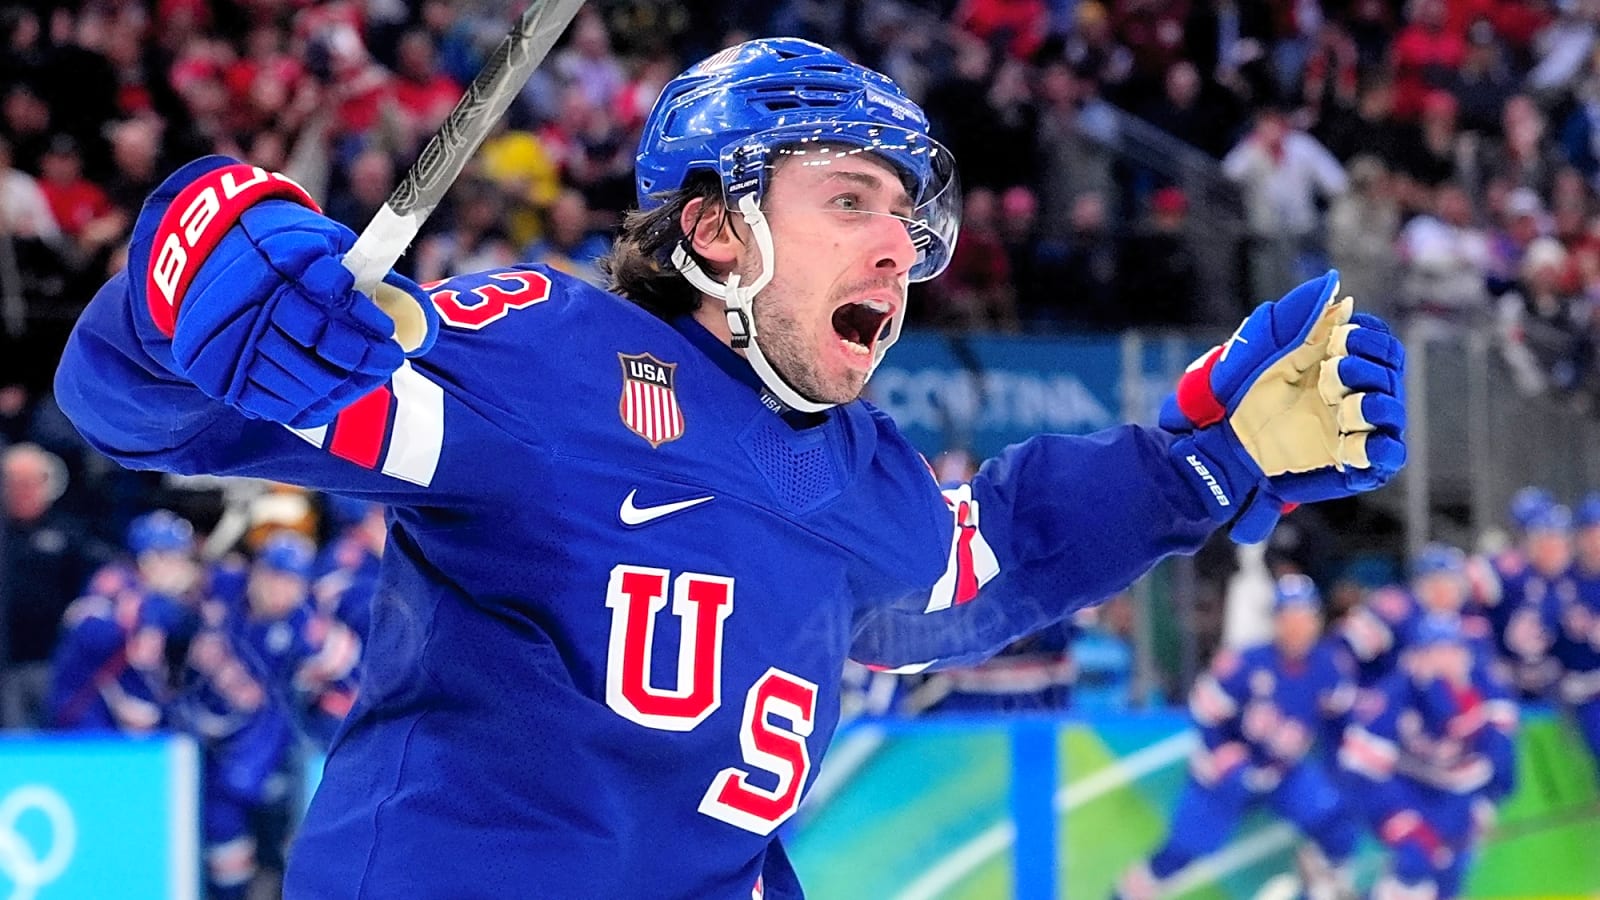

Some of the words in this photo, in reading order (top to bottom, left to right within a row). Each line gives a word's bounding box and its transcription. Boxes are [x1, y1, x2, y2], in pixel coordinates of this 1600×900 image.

[729, 178, 759, 192] BAUER
[153, 166, 313, 306] BAU
[420, 270, 552, 330] 3
[630, 361, 667, 384] USA
[760, 394, 782, 414] USA
[1186, 454, 1230, 506] BAUER
